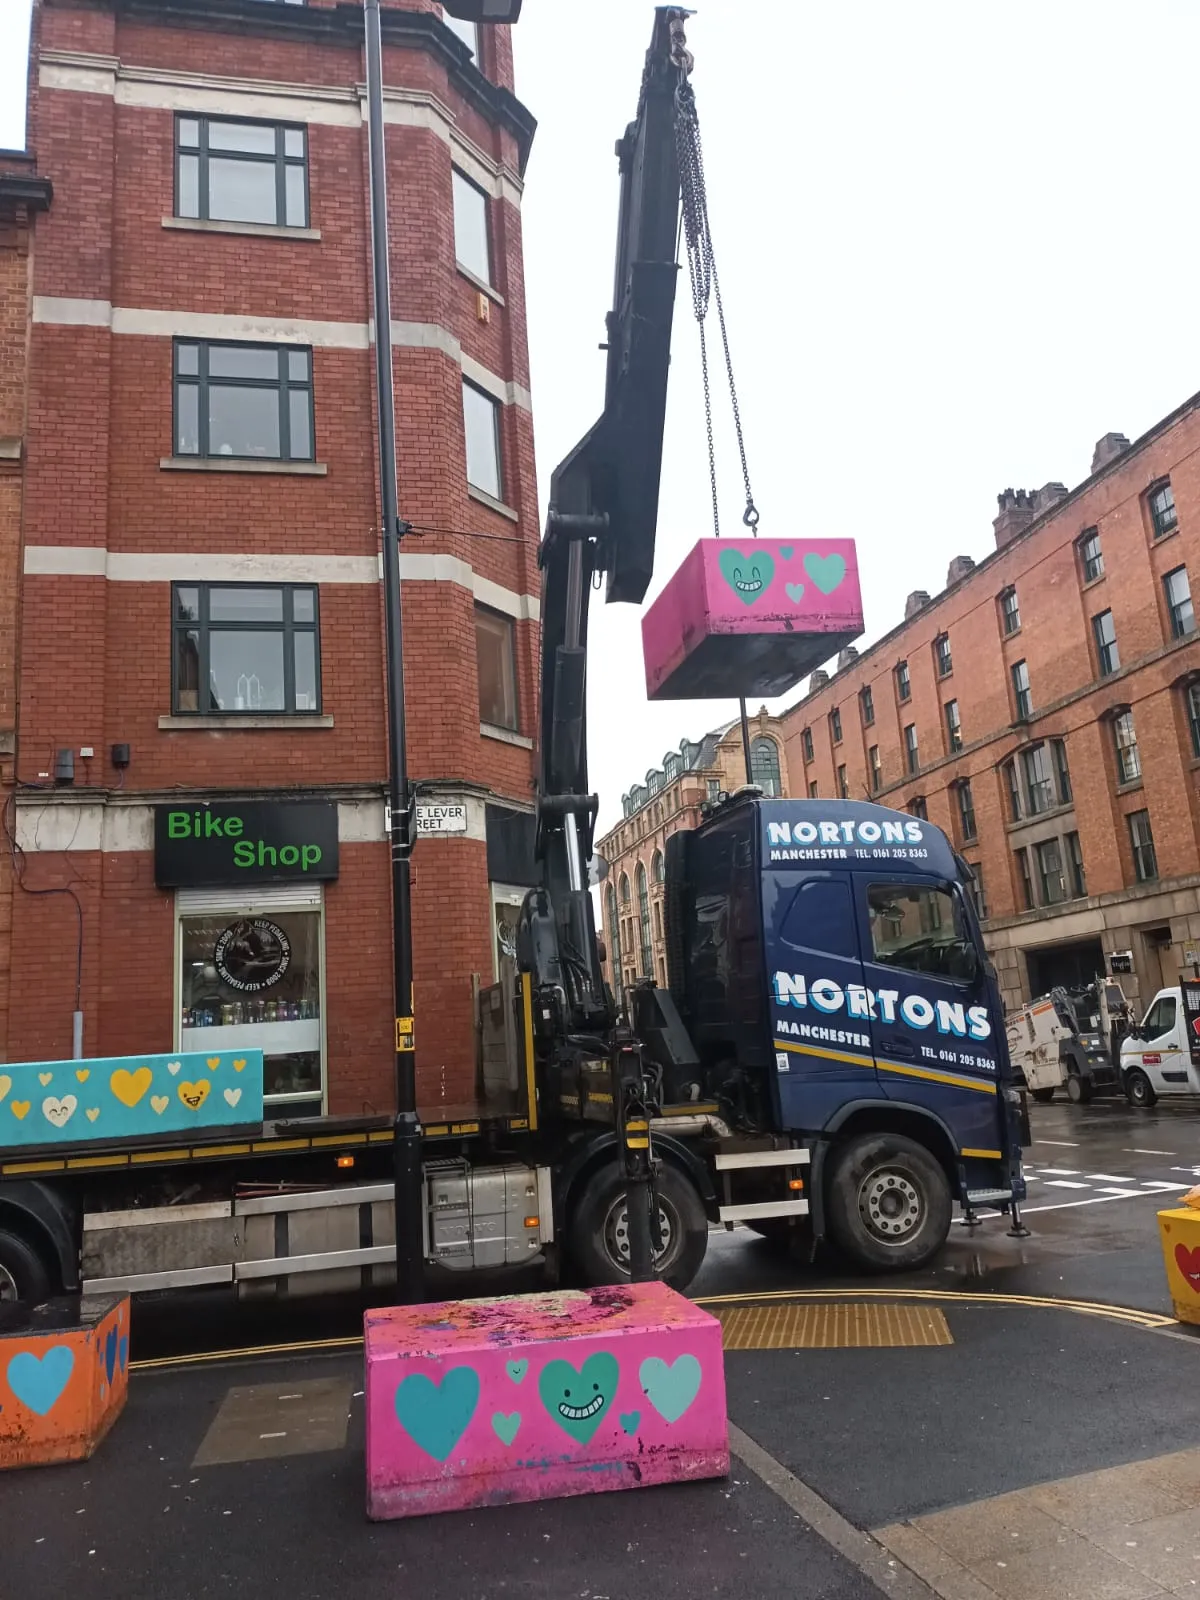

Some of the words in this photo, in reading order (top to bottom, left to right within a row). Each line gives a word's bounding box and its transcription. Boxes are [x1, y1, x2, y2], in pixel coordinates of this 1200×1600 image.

[168, 810, 244, 839] Bike
[416, 818, 443, 829] REET
[427, 807, 463, 818] LEVER
[767, 821, 924, 846] NORTONS
[233, 840, 322, 871] Shop
[770, 848, 847, 861] MANCHESTER
[854, 848, 871, 859] TEL.
[873, 848, 890, 859] 0161
[892, 848, 907, 858] 205
[909, 848, 928, 858] 8363
[772, 970, 991, 1041] NORTONS
[776, 1019, 871, 1048] MANCHESTER
[920, 1045, 938, 1059] TEL.
[939, 1050, 957, 1063] 0161
[959, 1054, 975, 1066] 205
[976, 1057, 996, 1070] 8363
